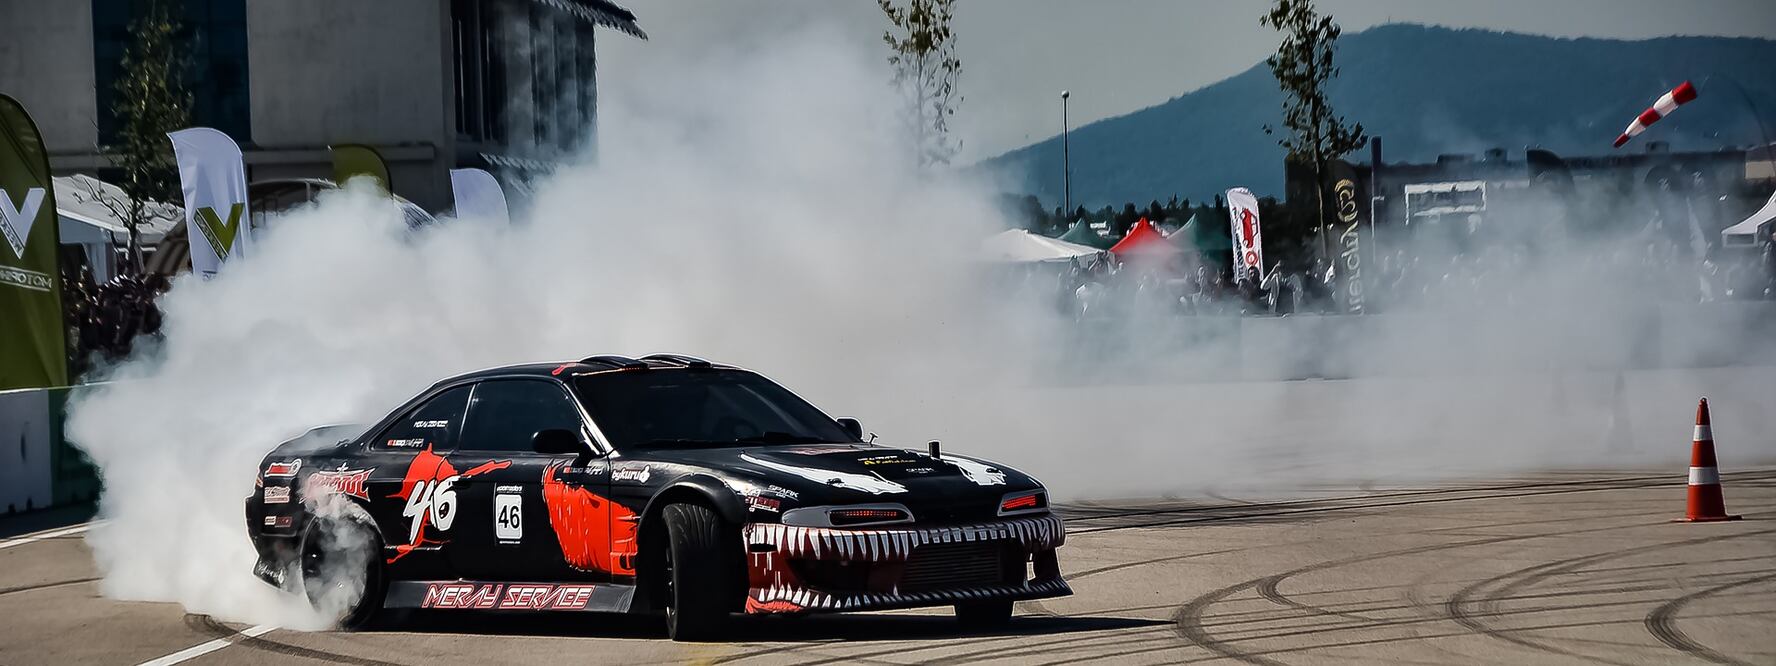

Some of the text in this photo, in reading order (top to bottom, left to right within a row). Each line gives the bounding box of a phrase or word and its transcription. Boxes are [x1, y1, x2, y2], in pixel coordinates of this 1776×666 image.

[767, 484, 799, 498] SPARK
[403, 475, 460, 545] 46
[498, 505, 520, 529] 46
[422, 585, 596, 609] MERAY SERVICE
